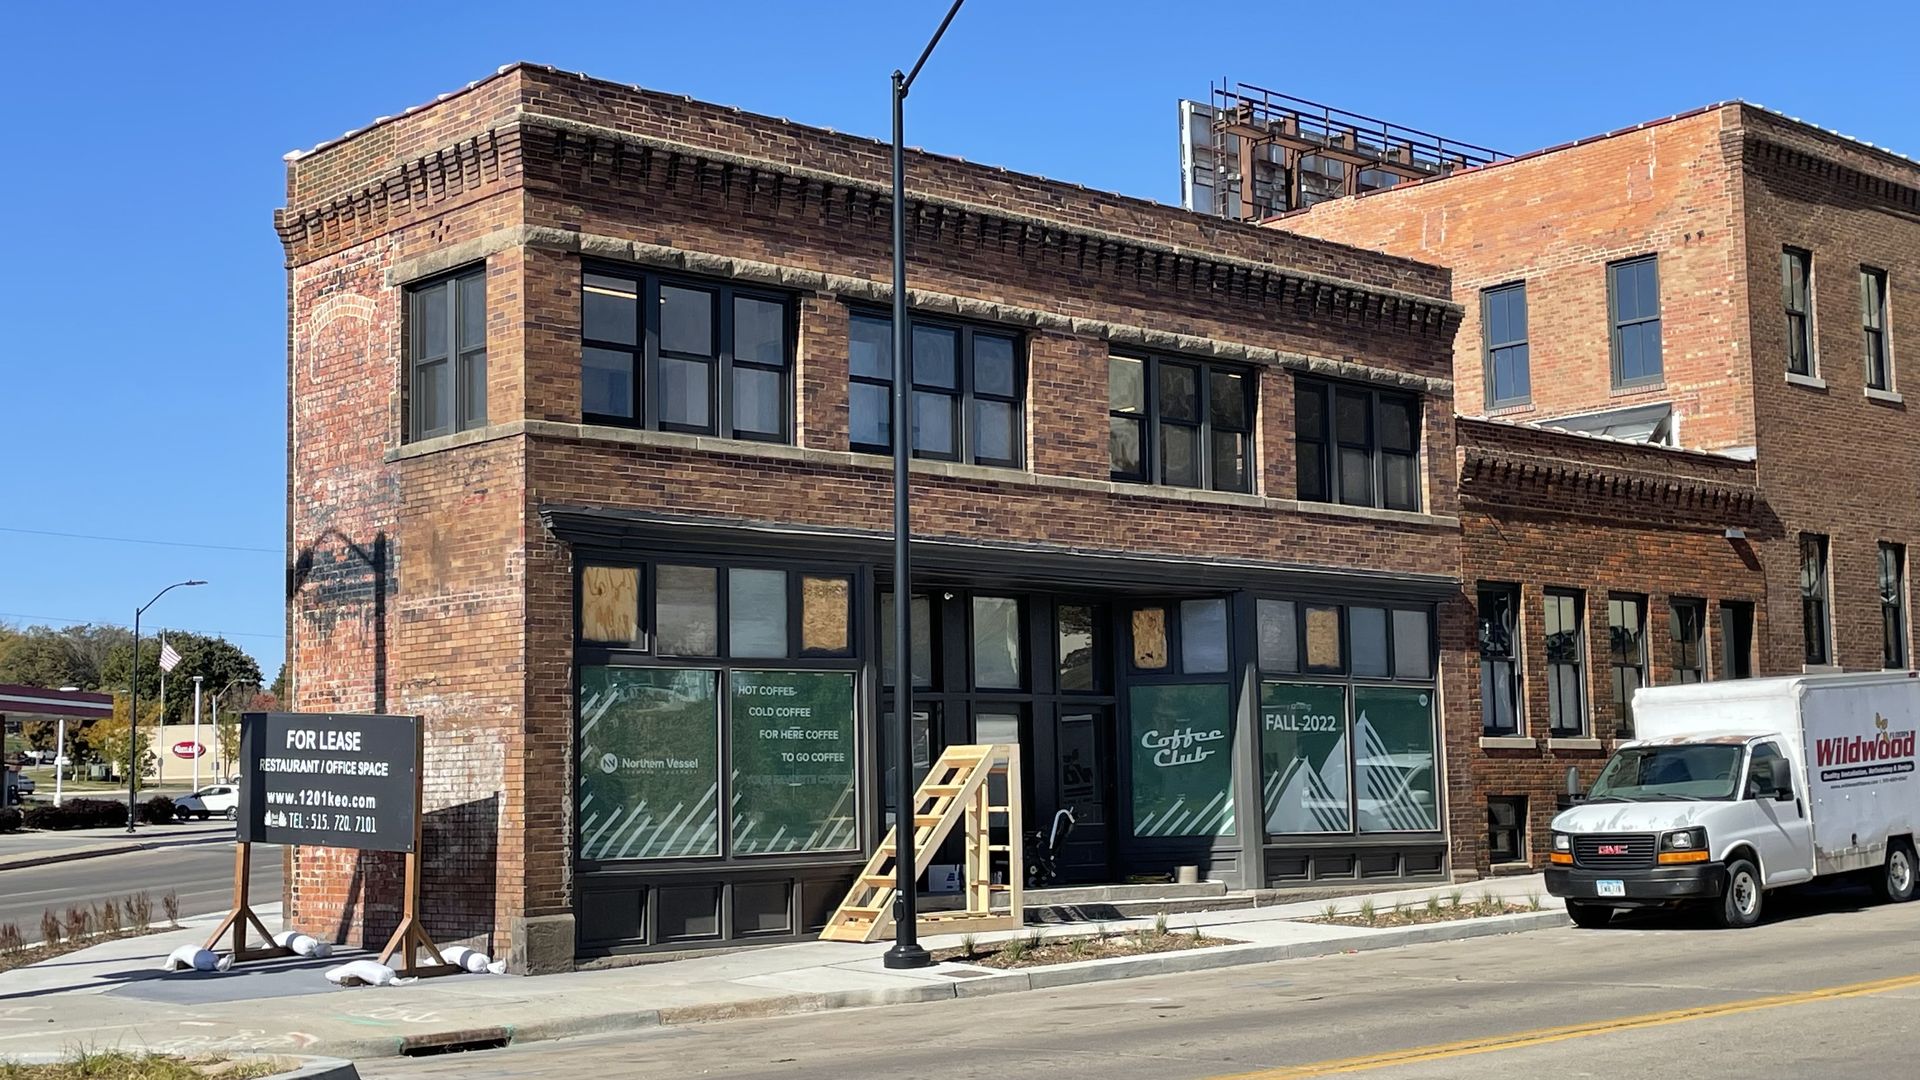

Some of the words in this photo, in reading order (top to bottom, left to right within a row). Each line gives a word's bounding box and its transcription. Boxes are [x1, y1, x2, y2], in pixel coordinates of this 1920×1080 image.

[738, 686, 757, 696] HOT
[759, 686, 795, 696] COFFEE
[748, 707, 774, 717] COLD
[776, 707, 811, 717] COFFEE
[1266, 714, 1299, 731] FALL
[1303, 715, 1337, 732] 2022
[286, 730, 317, 750] FOR
[319, 731, 361, 751] LEASE
[759, 730, 778, 739] FOR
[780, 730, 804, 740] HERE
[805, 730, 839, 740] COFFEE
[1141, 727, 1225, 750] Coffee
[781, 752, 795, 762] TO
[796, 752, 810, 762] GO
[811, 752, 845, 762] COFFEE
[1153, 747, 1216, 767] Club
[1816, 730, 1916, 767] Wildwood
[259, 758, 320, 774] RESTAURANT
[325, 760, 356, 775] OFFICE
[358, 761, 389, 777] SPACE
[622, 757, 665, 769] Northern
[666, 757, 699, 769] Vessel
[266, 789, 376, 809] www.1201keo.com
